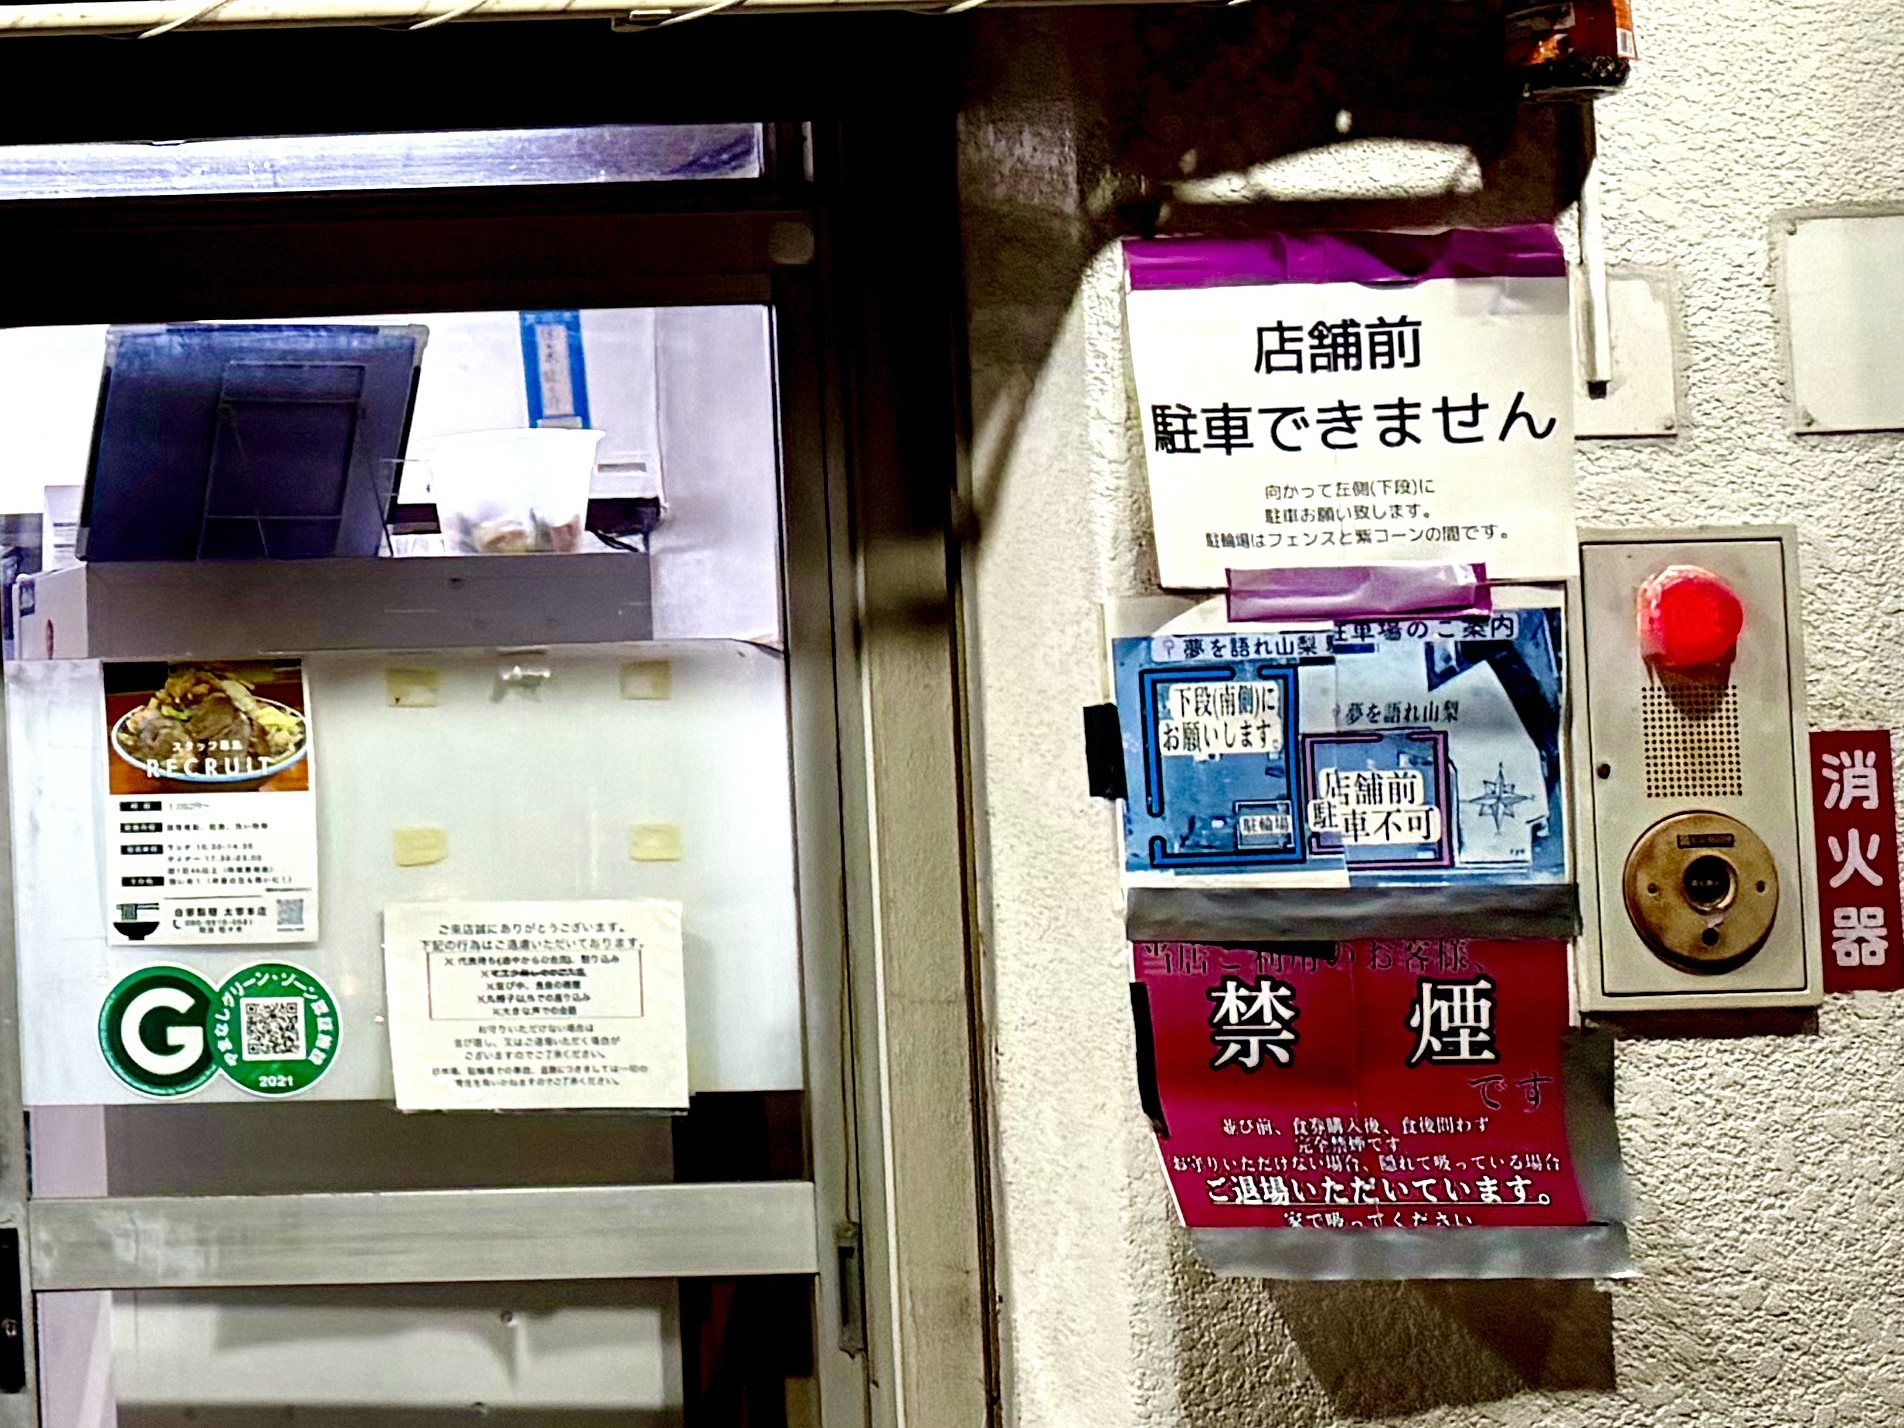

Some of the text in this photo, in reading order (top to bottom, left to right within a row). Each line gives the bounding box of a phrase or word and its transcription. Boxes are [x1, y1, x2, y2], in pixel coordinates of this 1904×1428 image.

[1254, 315, 1422, 374] 店舗前
[1152, 391, 1556, 456] 駐車できません
[1265, 478, 1435, 500] 向かって左側(下段)に
[1265, 504, 1431, 524] 駐車お願い致します。
[1206, 523, 1508, 549] 駐輪場はフェンスと紫コーンの間です。
[1183, 636, 1322, 658] 夢を語れ山梨
[1174, 684, 1277, 719] 下段(南側)に
[1345, 701, 1460, 724] 夢を語れ山梨
[1163, 722, 1280, 753] お願いします。
[147, 756, 272, 778] RECRUIT
[1325, 771, 1417, 807] 店舗前
[1313, 801, 1433, 843] 駐車不可
[1821, 749, 1889, 967] 消火器
[439, 924, 625, 935] ご来店誠にありがとうございます。
[121, 988, 203, 1075] G
[258, 1075, 294, 1087] 2021
[1467, 1070, 1555, 1112] です
[1206, 1174, 1552, 1206] ご退場いただいています。
